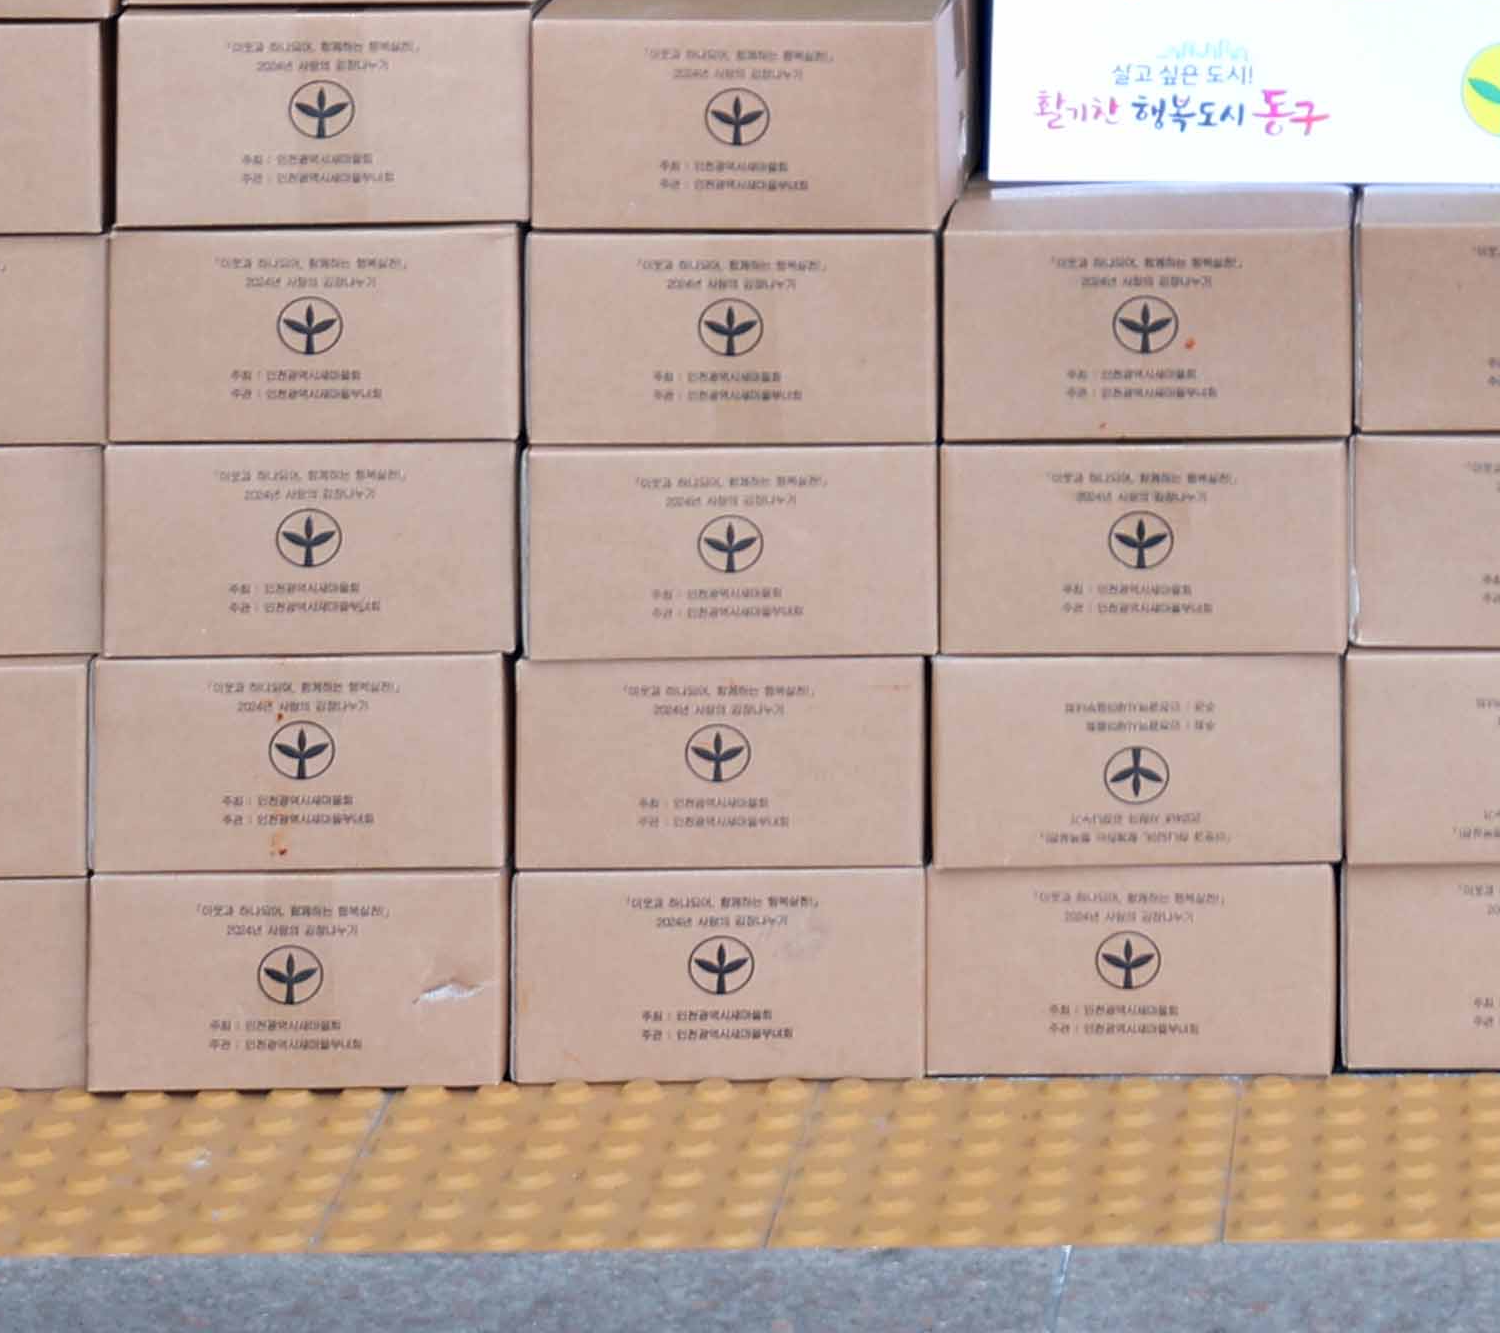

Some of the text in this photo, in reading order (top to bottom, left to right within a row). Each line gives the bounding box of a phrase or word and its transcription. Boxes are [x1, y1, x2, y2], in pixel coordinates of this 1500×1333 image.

[1111, 63, 1254, 86] 살고 싶은 도시!
[1032, 88, 1331, 137] 활기찬 행복도시 동구
